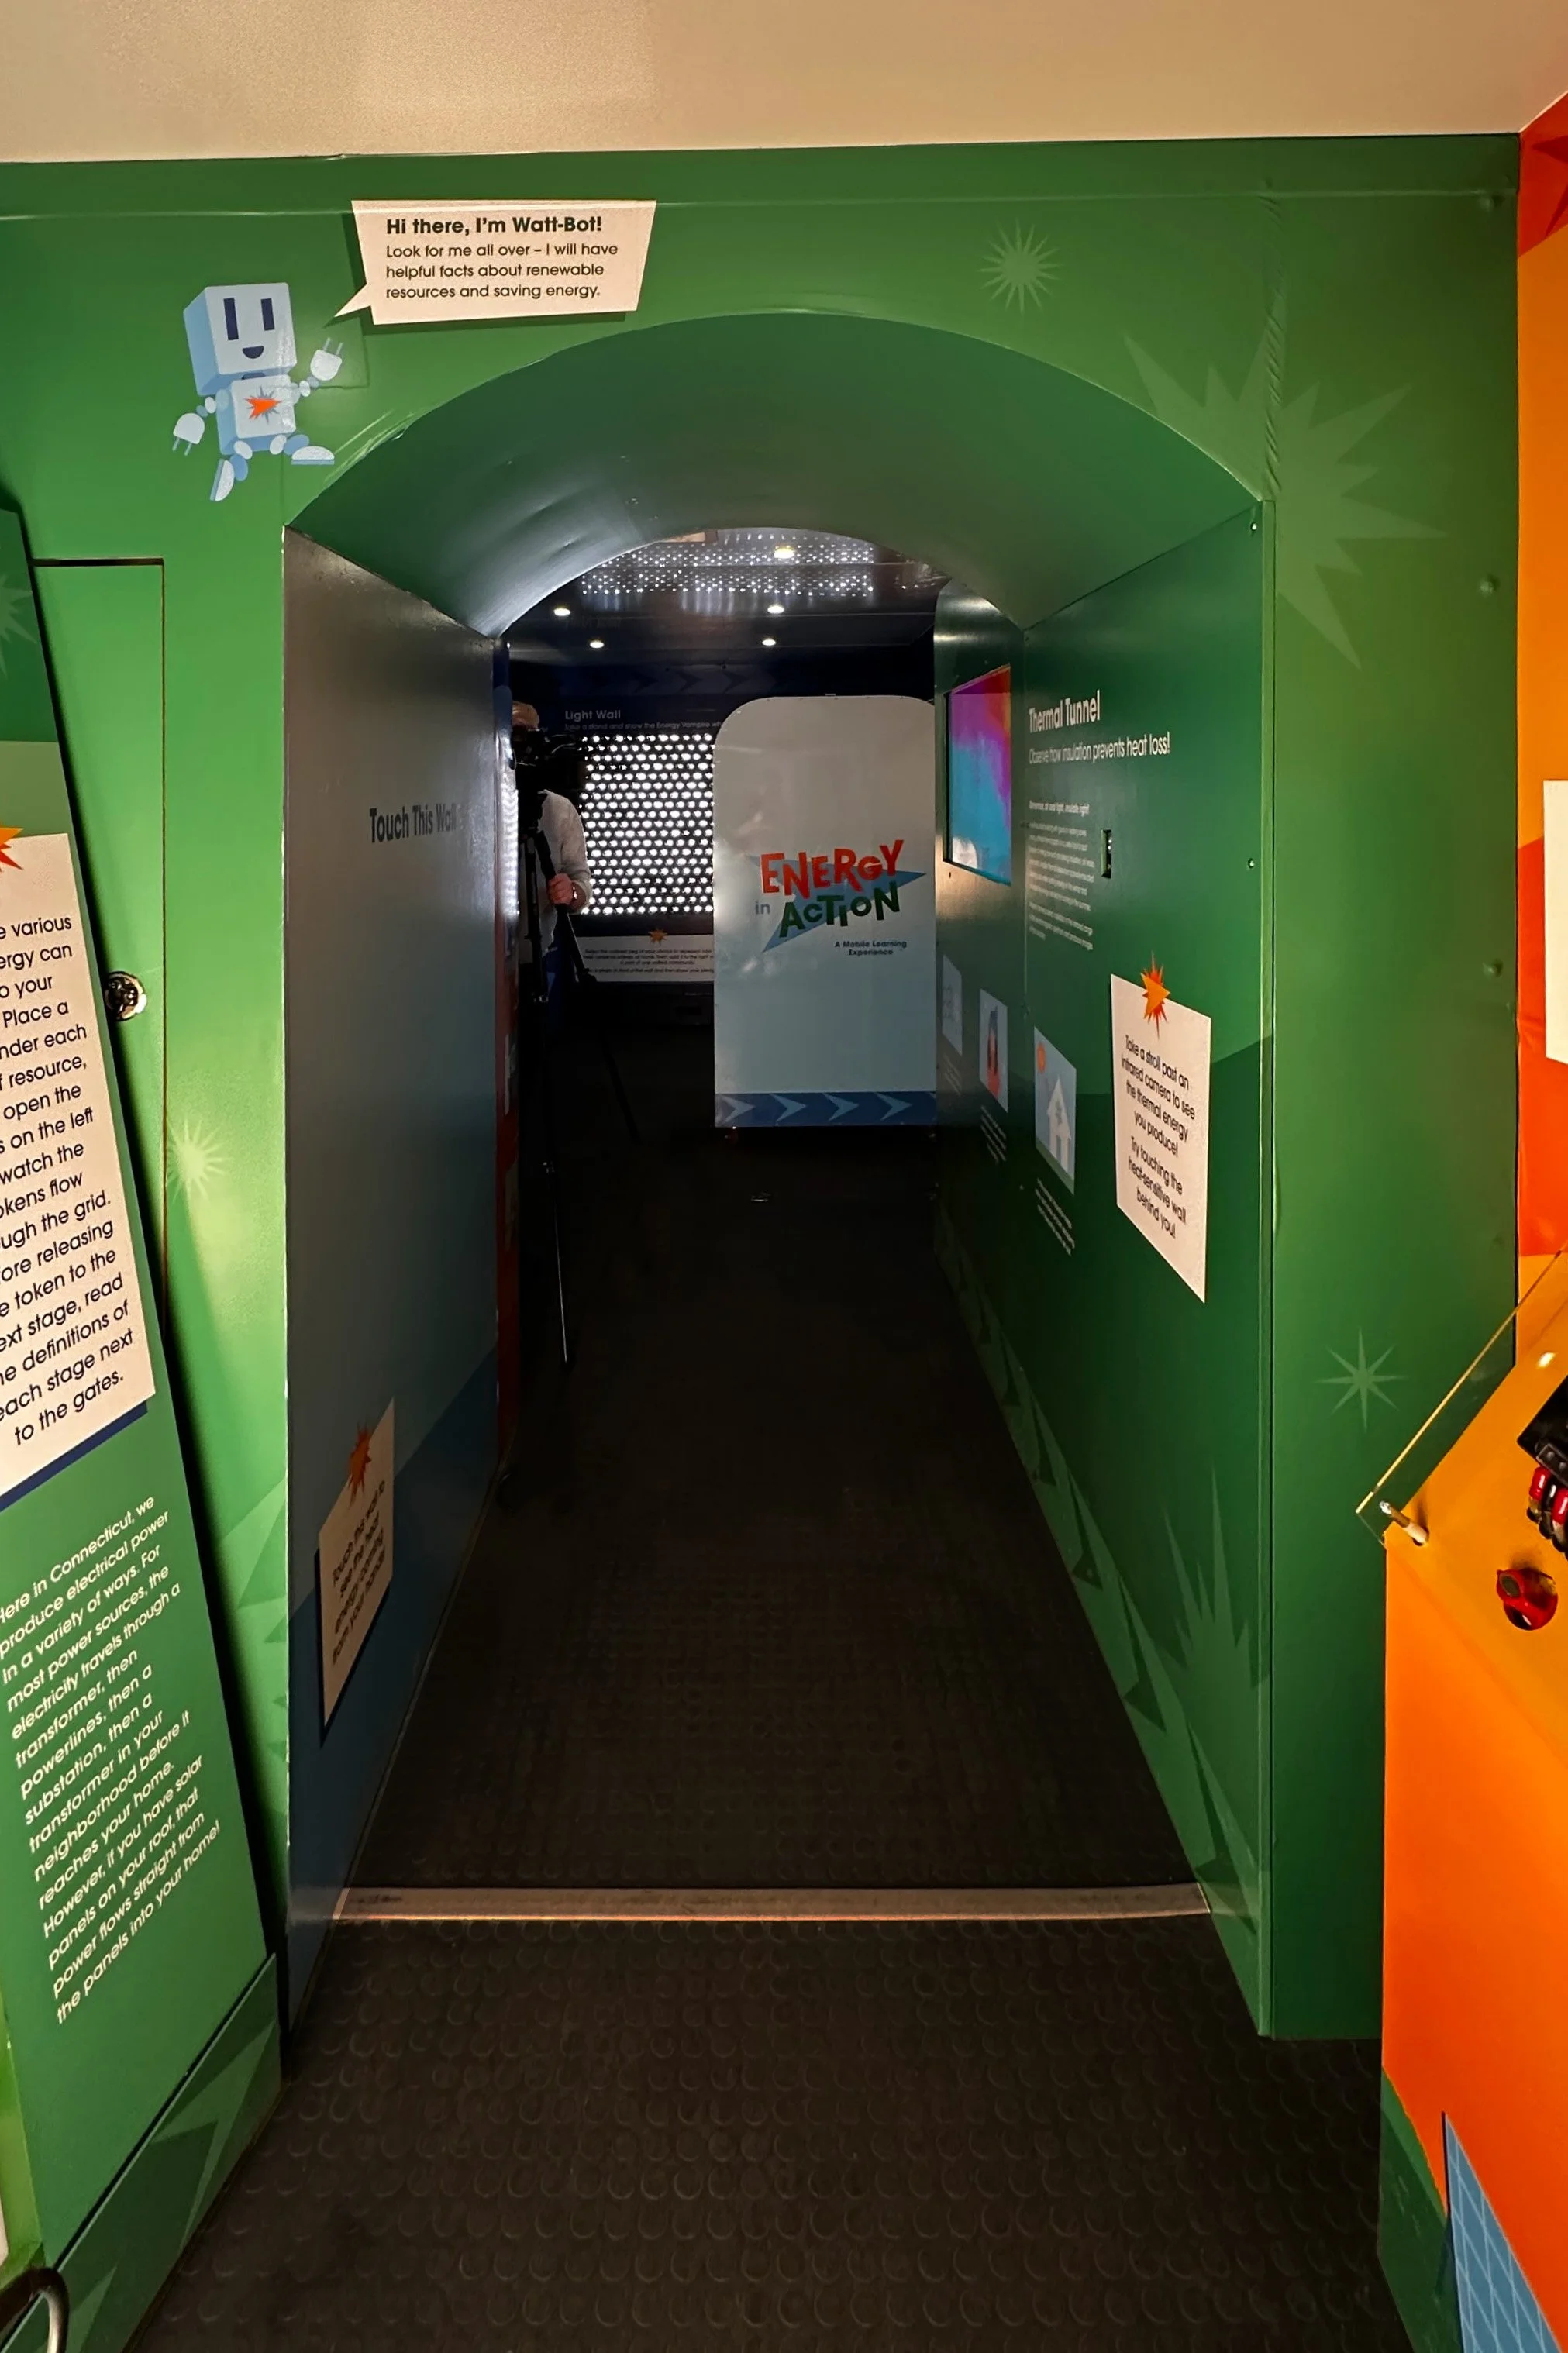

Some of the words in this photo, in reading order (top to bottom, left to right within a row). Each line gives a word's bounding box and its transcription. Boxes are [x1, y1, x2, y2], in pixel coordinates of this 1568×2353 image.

[386, 245, 421, 257] Look
[425, 245, 443, 257] for
[448, 246, 472, 257] me
[477, 244, 494, 256] all
[498, 246, 530, 256] over
[546, 243, 550, 255] I
[554, 243, 577, 255] will
[581, 243, 618, 255] have
[387, 219, 406, 234] Hi
[412, 219, 470, 236] there,
[512, 216, 601, 233] Watt-Bot!
[386, 265, 435, 280] helpful
[439, 265, 474, 277] facts
[478, 264, 522, 277] about
[527, 264, 604, 276] renewable
[386, 288, 456, 298] resources
[460, 285, 489, 297] and
[494, 284, 541, 299] saving
[546, 285, 601, 299] energy.
[565, 710, 592, 722] Light
[597, 710, 621, 719] Wall
[1029, 700, 1063, 733] Thermal
[1065, 690, 1101, 726] Tunnel
[1093, 736, 1125, 763] prevents
[1126, 734, 1147, 757] heat
[1149, 731, 1170, 755] loss!
[370, 806, 409, 843] Touch
[412, 804, 433, 836] This
[760, 839, 904, 899] ENERGY
[11, 917, 72, 937] various
[755, 901, 770, 915] in
[40, 944, 73, 961] can
[872, 940, 907, 949] Learning
[3, 1006, 52, 1028] Place
[57, 1001, 68, 1015] a
[15, 977, 53, 999] your
[44, 1023, 87, 1048] each
[1125, 1034, 1139, 1056] Take
[1140, 1048, 1144, 1059] a
[1146, 1051, 1160, 1071] stroll
[1162, 1063, 1177, 1082] past
[1178, 1074, 1189, 1090] an
[9, 1056, 87, 1088] resource,
[1145, 1074, 1170, 1102] camera
[1172, 1090, 1180, 1108] to
[1181, 1101, 1195, 1120] see
[3, 1094, 50, 1121] open
[54, 1085, 81, 1104] the
[11, 1130, 34, 1149] on
[38, 1120, 65, 1140] the
[70, 1107, 93, 1129] left
[1126, 1079, 1136, 1099] the
[1137, 1087, 1161, 1118] thermal
[1163, 1111, 1189, 1143] energy
[1134, 1110, 1146, 1130] you
[1147, 1121, 1178, 1157] produce!
[0, 1152, 53, 1185] watch
[57, 1143, 84, 1163] the
[50, 1172, 84, 1197] flow
[1129, 1156, 1170, 1208] heat-sensitive
[1172, 1201, 1187, 1225] wall
[1131, 1135, 1139, 1157] Try
[1141, 1145, 1170, 1187] touching
[1170, 1172, 1183, 1195] the
[41, 1211, 70, 1232] the
[74, 1190, 112, 1221] grid.
[1136, 1187, 1160, 1221] behind
[1161, 1212, 1176, 1239] you!
[37, 1220, 114, 1267] releasing
[15, 1274, 65, 1310] token
[69, 1264, 87, 1283] to
[90, 1249, 116, 1272] the
[28, 1301, 82, 1337] stage,
[84, 1271, 124, 1307] read
[22, 1313, 109, 1372] definitions
[113, 1299, 129, 1321] of
[47, 1353, 95, 1391] stage
[99, 1327, 133, 1362] next
[14, 1424, 34, 1446] to
[39, 1403, 68, 1431] the
[73, 1370, 124, 1413] gates.
[33, 1578, 48, 1597] in
[50, 1511, 135, 1583] Connecticut,
[135, 1496, 155, 1517] we
[0, 1597, 64, 1660] produce
[67, 1541, 129, 1600] electrical
[130, 1511, 169, 1552] power
[20, 1651, 33, 1669] a
[36, 1607, 84, 1655] variety
[87, 1590, 101, 1614] of
[103, 1565, 140, 1598] ways.
[141, 1544, 160, 1569] For
[7, 1669, 45, 1713] most
[47, 1630, 93, 1681] power
[95, 1586, 148, 1637] sources,
[148, 1566, 169, 1589] the
[12, 1672, 79, 1740] electricity
[81, 1634, 122, 1678] travels
[123, 1592, 170, 1640] through
[171, 1583, 181, 1597] a
[16, 1681, 105, 1769] transformer,
[107, 1649, 138, 1684] then
[20, 1711, 107, 1800] powerlines,
[109, 1677, 140, 1713] then
[142, 1665, 152, 1680] a
[25, 1742, 107, 1825] substation,
[109, 1707, 140, 1742] then
[143, 1693, 152, 1708] a
[29, 1759, 115, 1854] transformer
[118, 1745, 132, 1764] in
[133, 1710, 163, 1749] your
[34, 1764, 137, 1882] neighborhood
[140, 1724, 180, 1772] before
[182, 1710, 191, 1727] it
[39, 1839, 99, 1910] reaches
[101, 1803, 132, 1845] your
[133, 1762, 174, 1807] home.
[43, 1864, 106, 1938] However,
[107, 1848, 115, 1868] if
[118, 1823, 143, 1859] you
[143, 1789, 174, 1828] have
[175, 1755, 203, 1792] solar
[48, 1905, 96, 1971] panels
[98, 1883, 116, 1909] on
[119, 1848, 146, 1889] your
[149, 1814, 175, 1852] roof,
[175, 1786, 198, 1821] that
[53, 1936, 97, 2000] power
[99, 1899, 132, 1941] flows
[133, 1841, 177, 1900] straight
[178, 1812, 205, 1848] from
[56, 1990, 81, 2024] the
[84, 1933, 129, 1996] panels
[129, 1902, 153, 1937] into
[156, 1866, 181, 1908] your
[184, 1820, 220, 1872] home!
